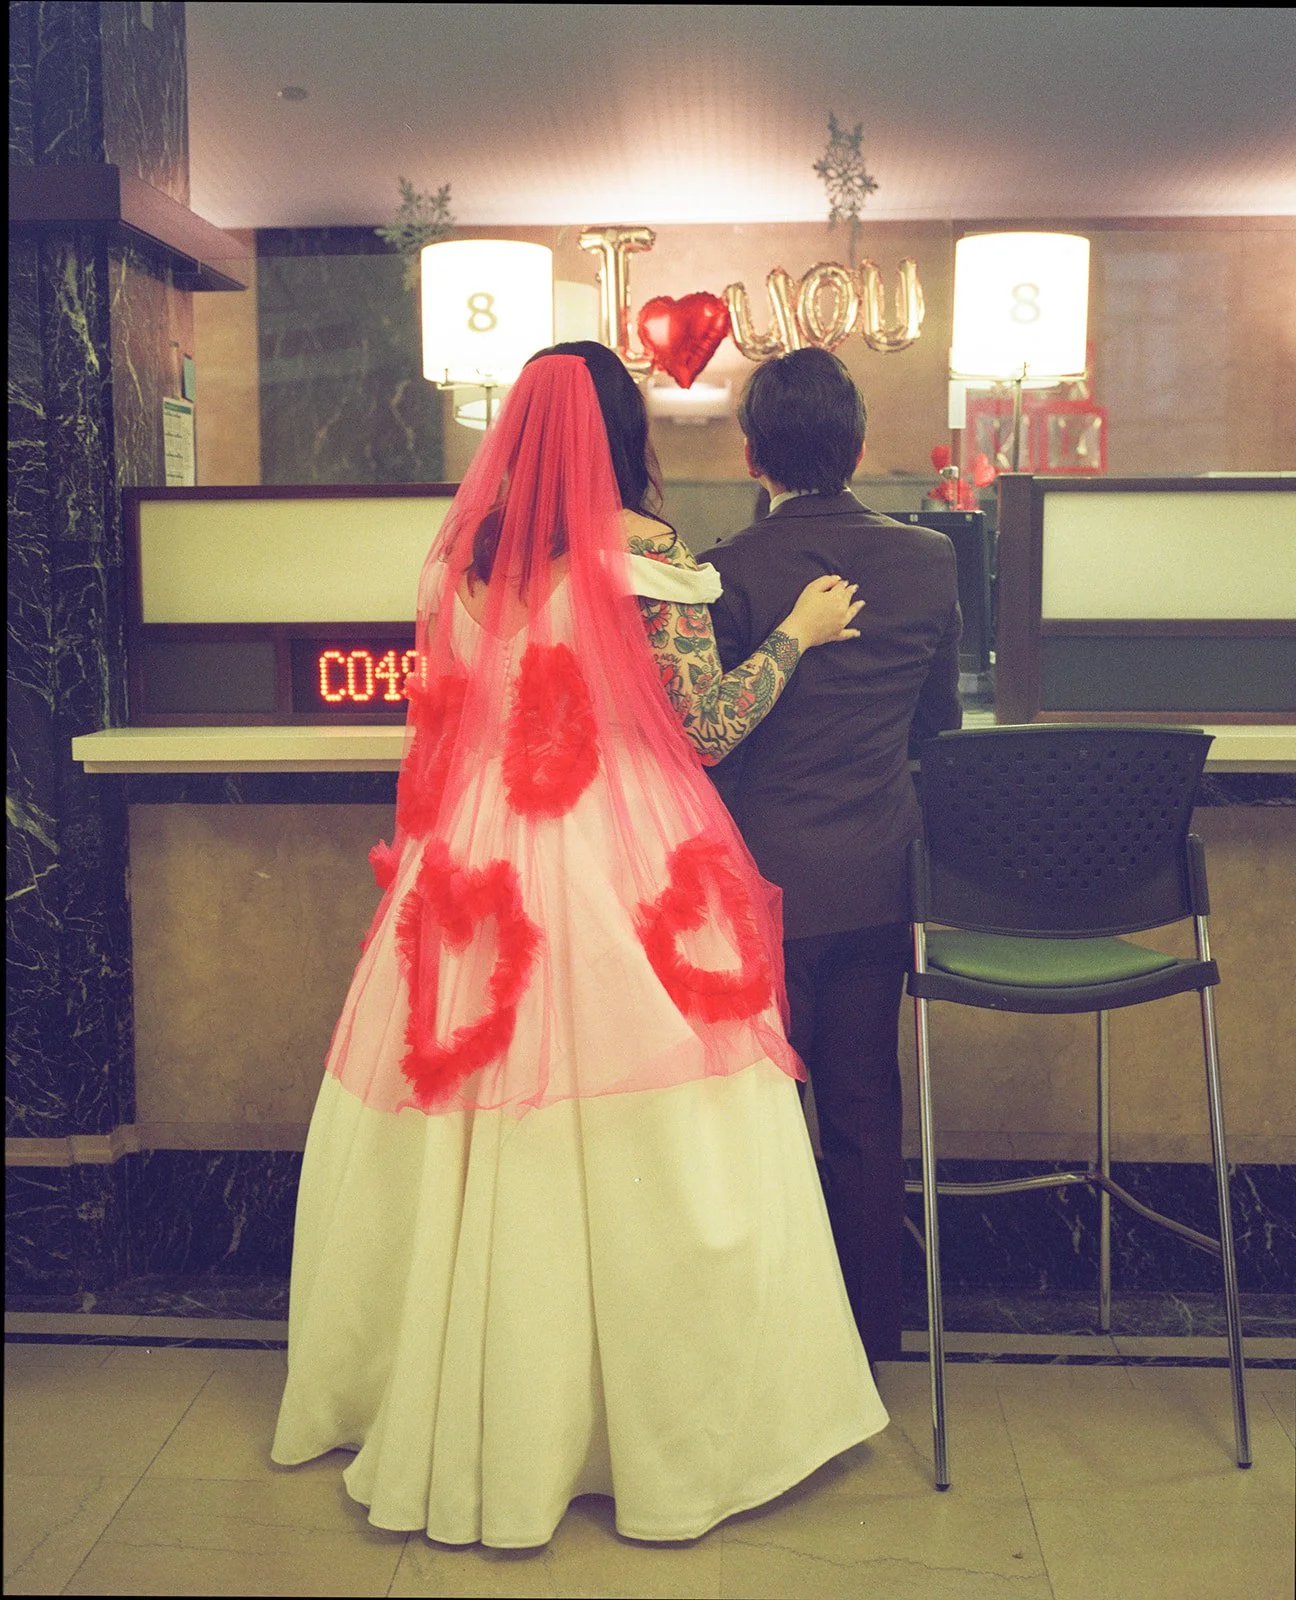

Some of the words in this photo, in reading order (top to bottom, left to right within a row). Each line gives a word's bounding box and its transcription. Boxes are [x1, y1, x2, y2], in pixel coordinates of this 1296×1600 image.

[466, 291, 498, 333] 8
[578, 226, 657, 384] I
[722, 256, 925, 362] YOU
[1009, 282, 1041, 324] 8
